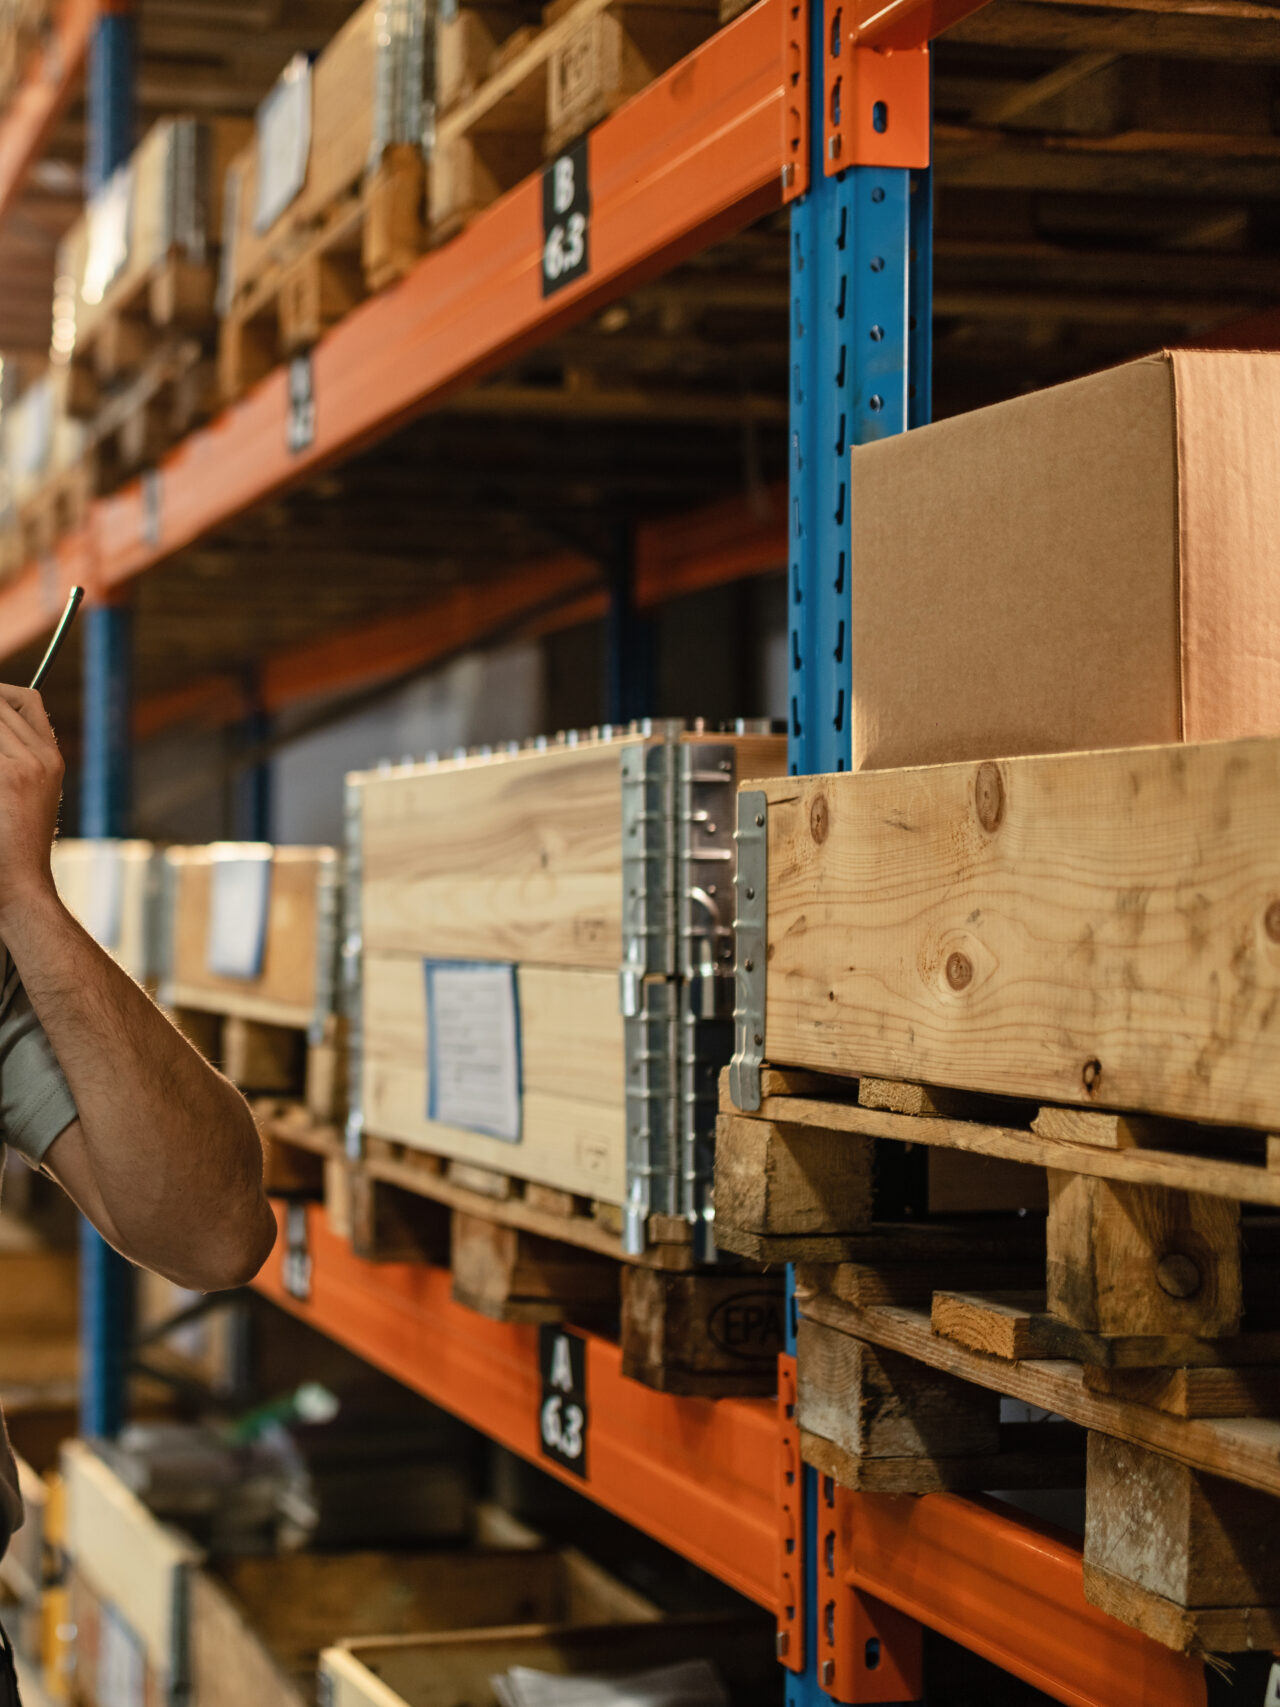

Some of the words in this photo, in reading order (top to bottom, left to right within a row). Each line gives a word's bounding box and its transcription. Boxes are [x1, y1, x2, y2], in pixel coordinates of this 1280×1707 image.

[554, 156, 575, 213] B
[544, 212, 586, 280] 6.3
[550, 1335, 573, 1393] A
[541, 1394, 583, 1459] 6.3
